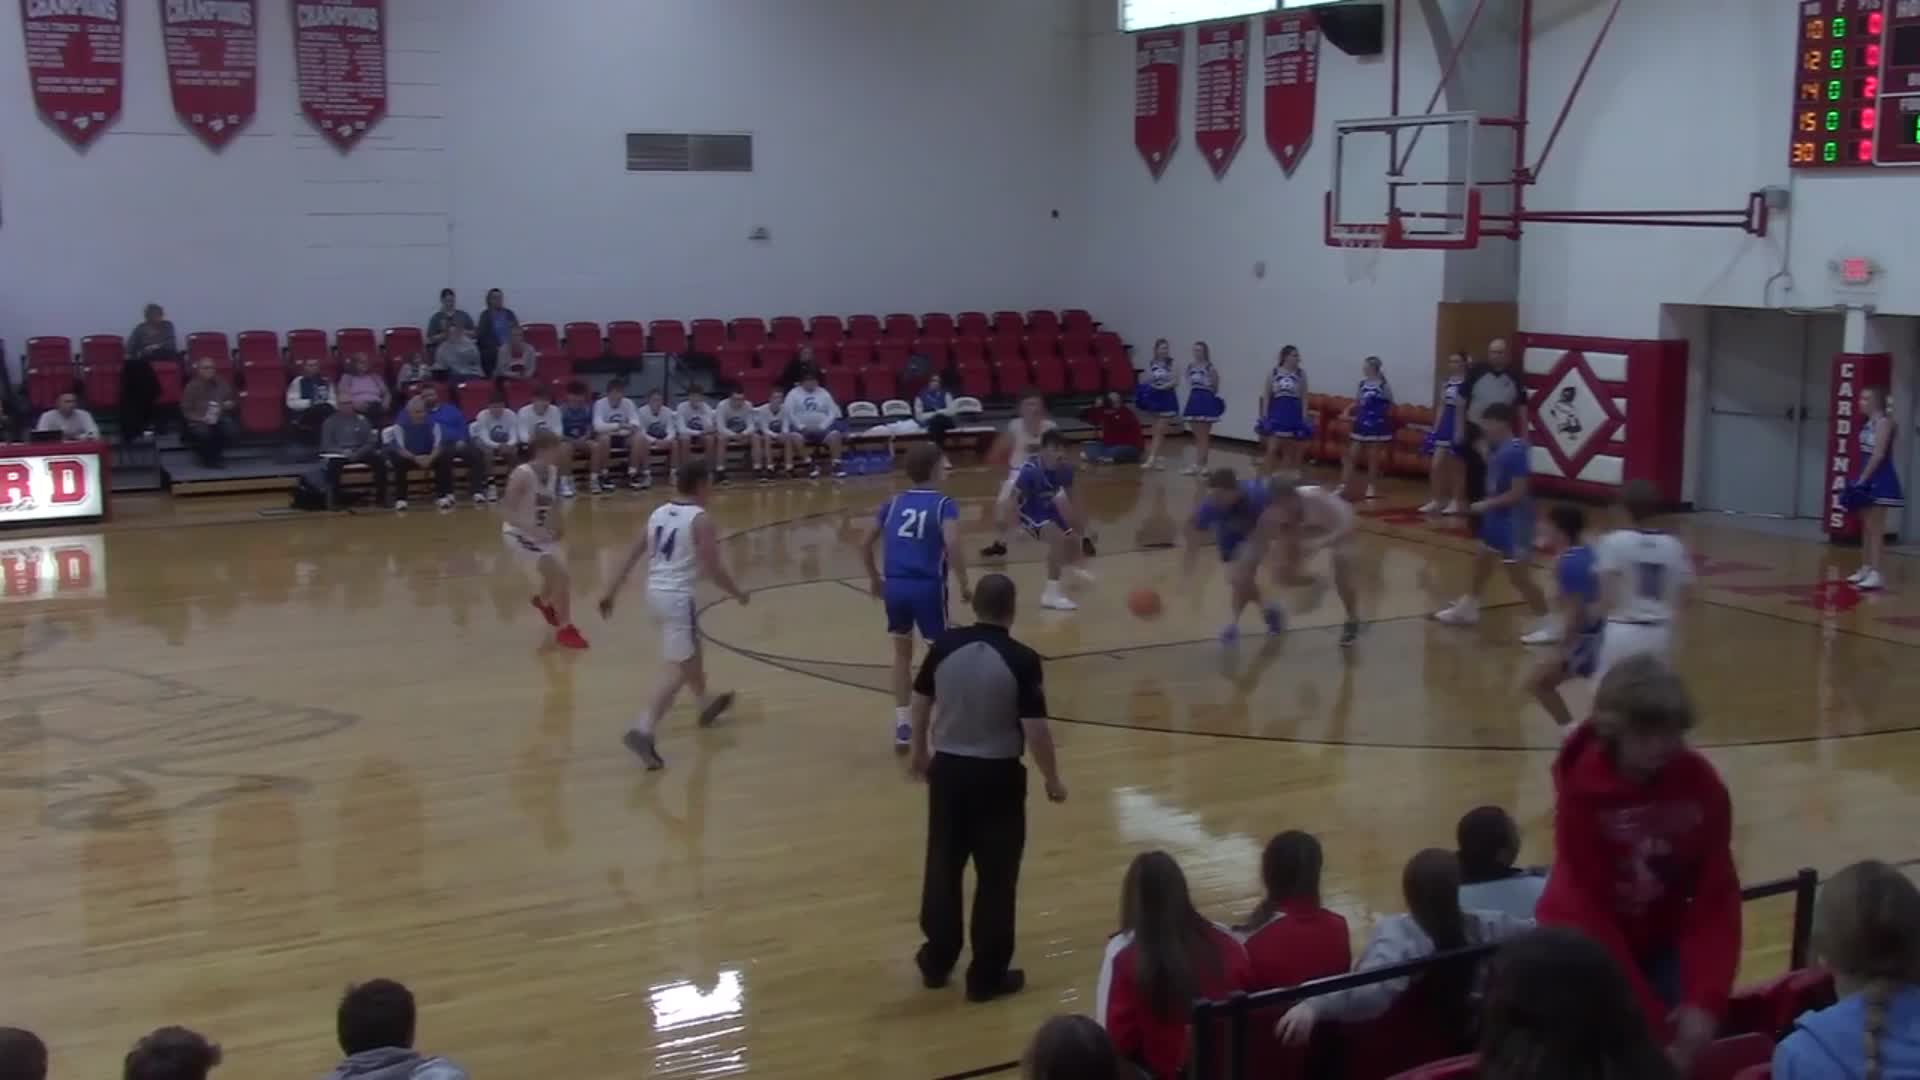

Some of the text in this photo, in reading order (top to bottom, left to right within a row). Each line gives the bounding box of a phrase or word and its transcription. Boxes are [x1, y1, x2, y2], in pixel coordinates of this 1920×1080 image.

[1832, 18, 1846, 37] 0
[1804, 51, 1821, 70] 12
[1830, 49, 1844, 69] 0
[1828, 80, 1841, 100] 0
[1864, 76, 1878, 98] 2
[1800, 112, 1816, 131] 15
[1825, 111, 1839, 131] 0
[1793, 143, 1815, 162] 30
[1824, 142, 1837, 161] 0
[1830, 364, 1854, 528] CARDINALS
[897, 508, 928, 539] 21
[655, 526, 679, 562] 14
